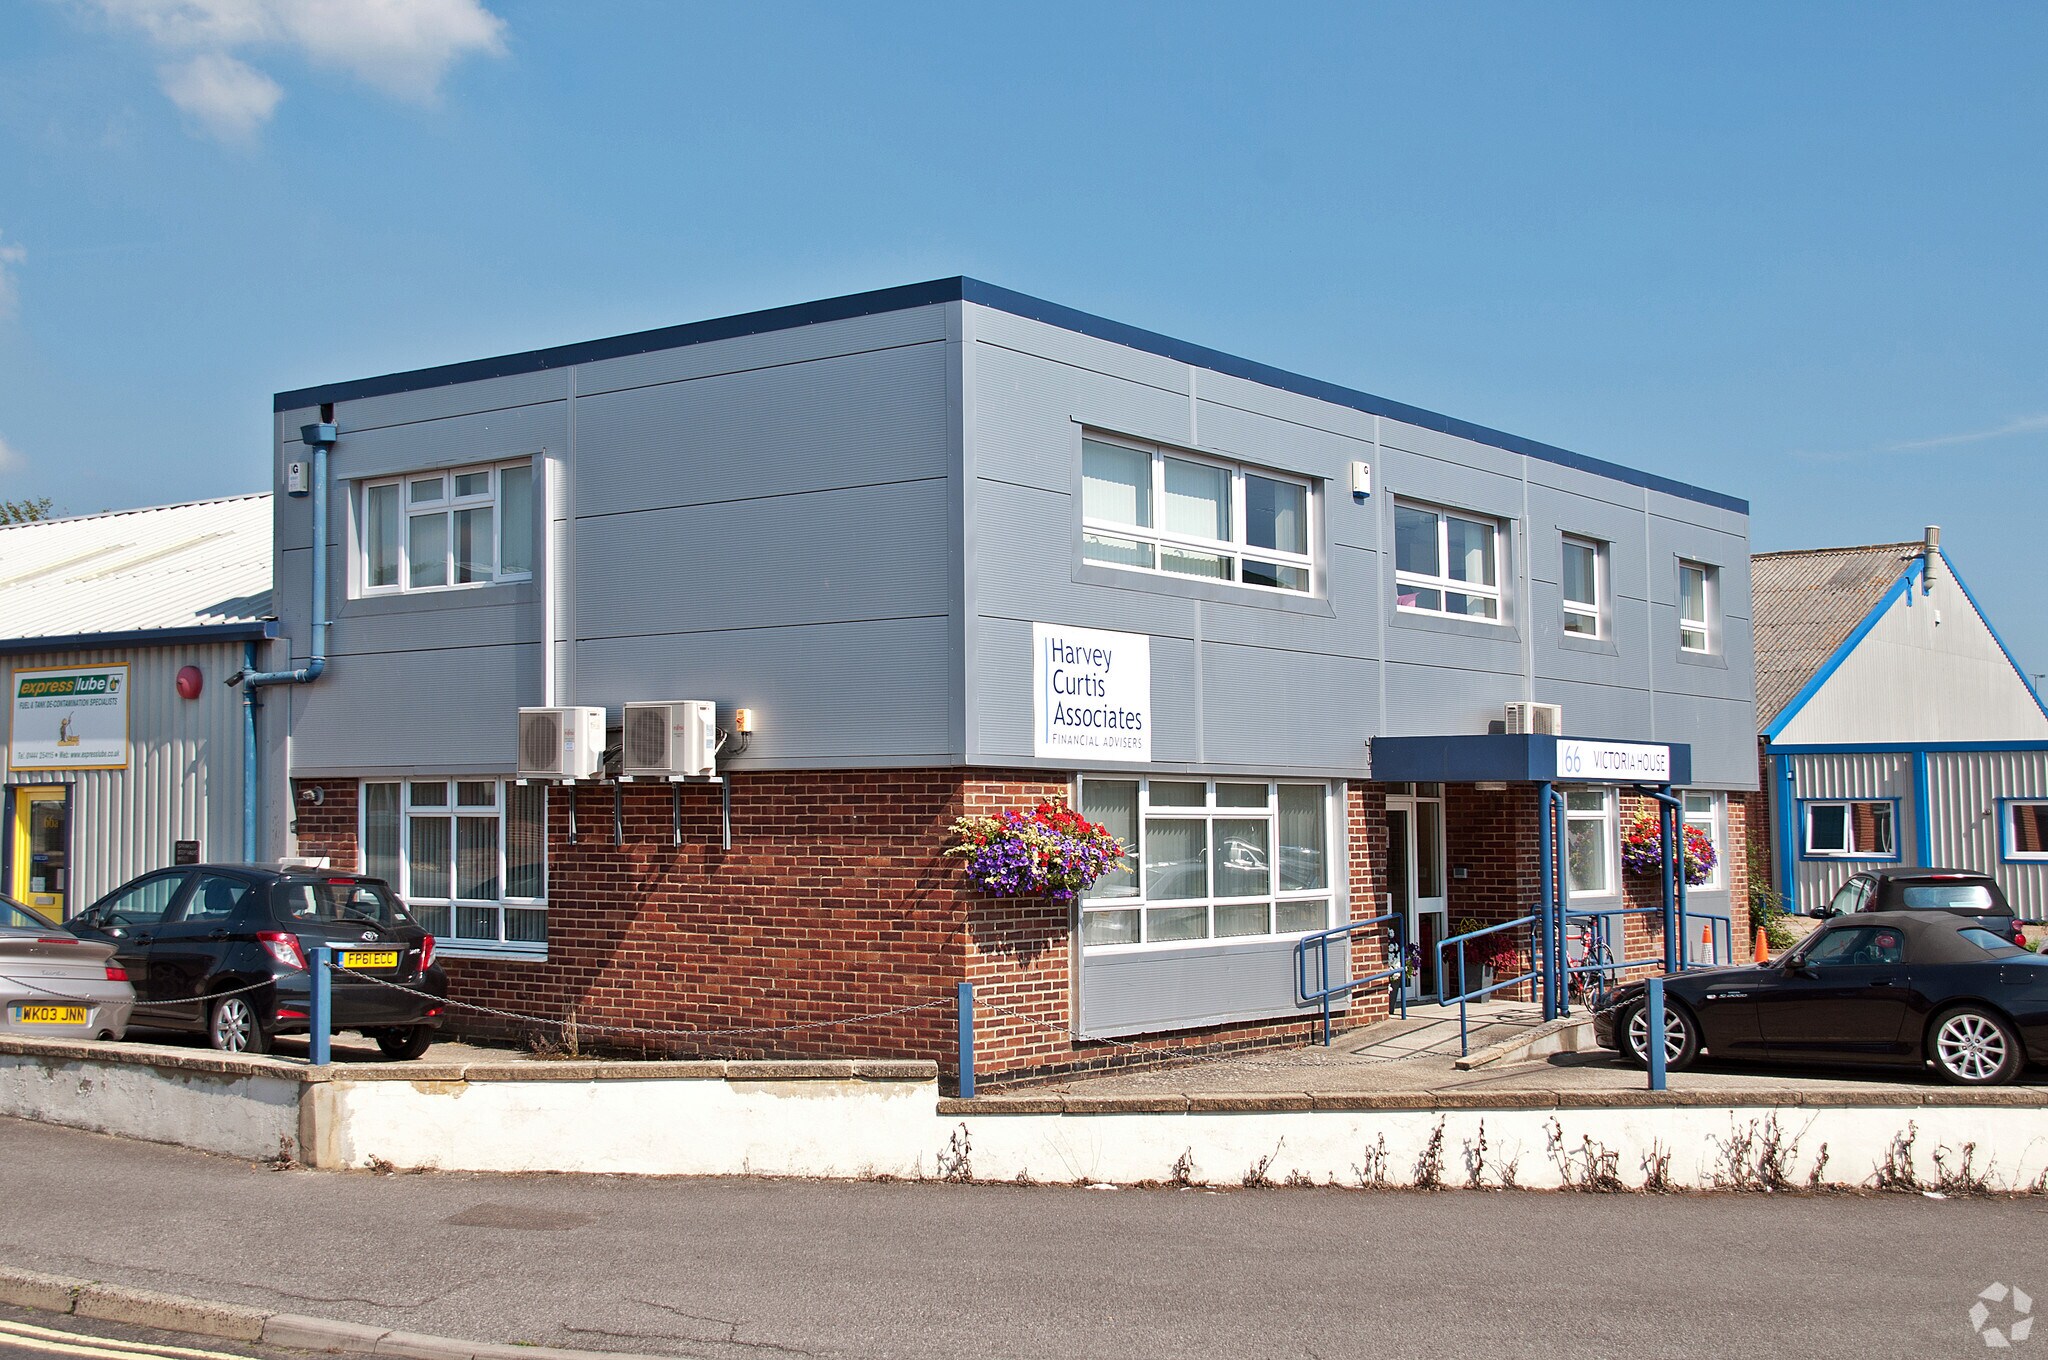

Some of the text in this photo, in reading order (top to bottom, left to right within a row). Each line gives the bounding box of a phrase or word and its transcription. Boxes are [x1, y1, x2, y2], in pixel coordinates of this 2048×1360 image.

[1052, 637, 1112, 673] Harvey
[20, 677, 105, 696] express lube
[1053, 669, 1105, 697] Curtis
[19, 701, 30, 709] FUEL
[89, 697, 118, 706] SPECIALISTS
[1053, 701, 1142, 730] Associates
[1052, 733, 1142, 749] FINANCIAL ADVISERS
[1565, 745, 1665, 773] 66 VICTORIA HOUSE
[23, 1007, 85, 1021] WK03 JNN
